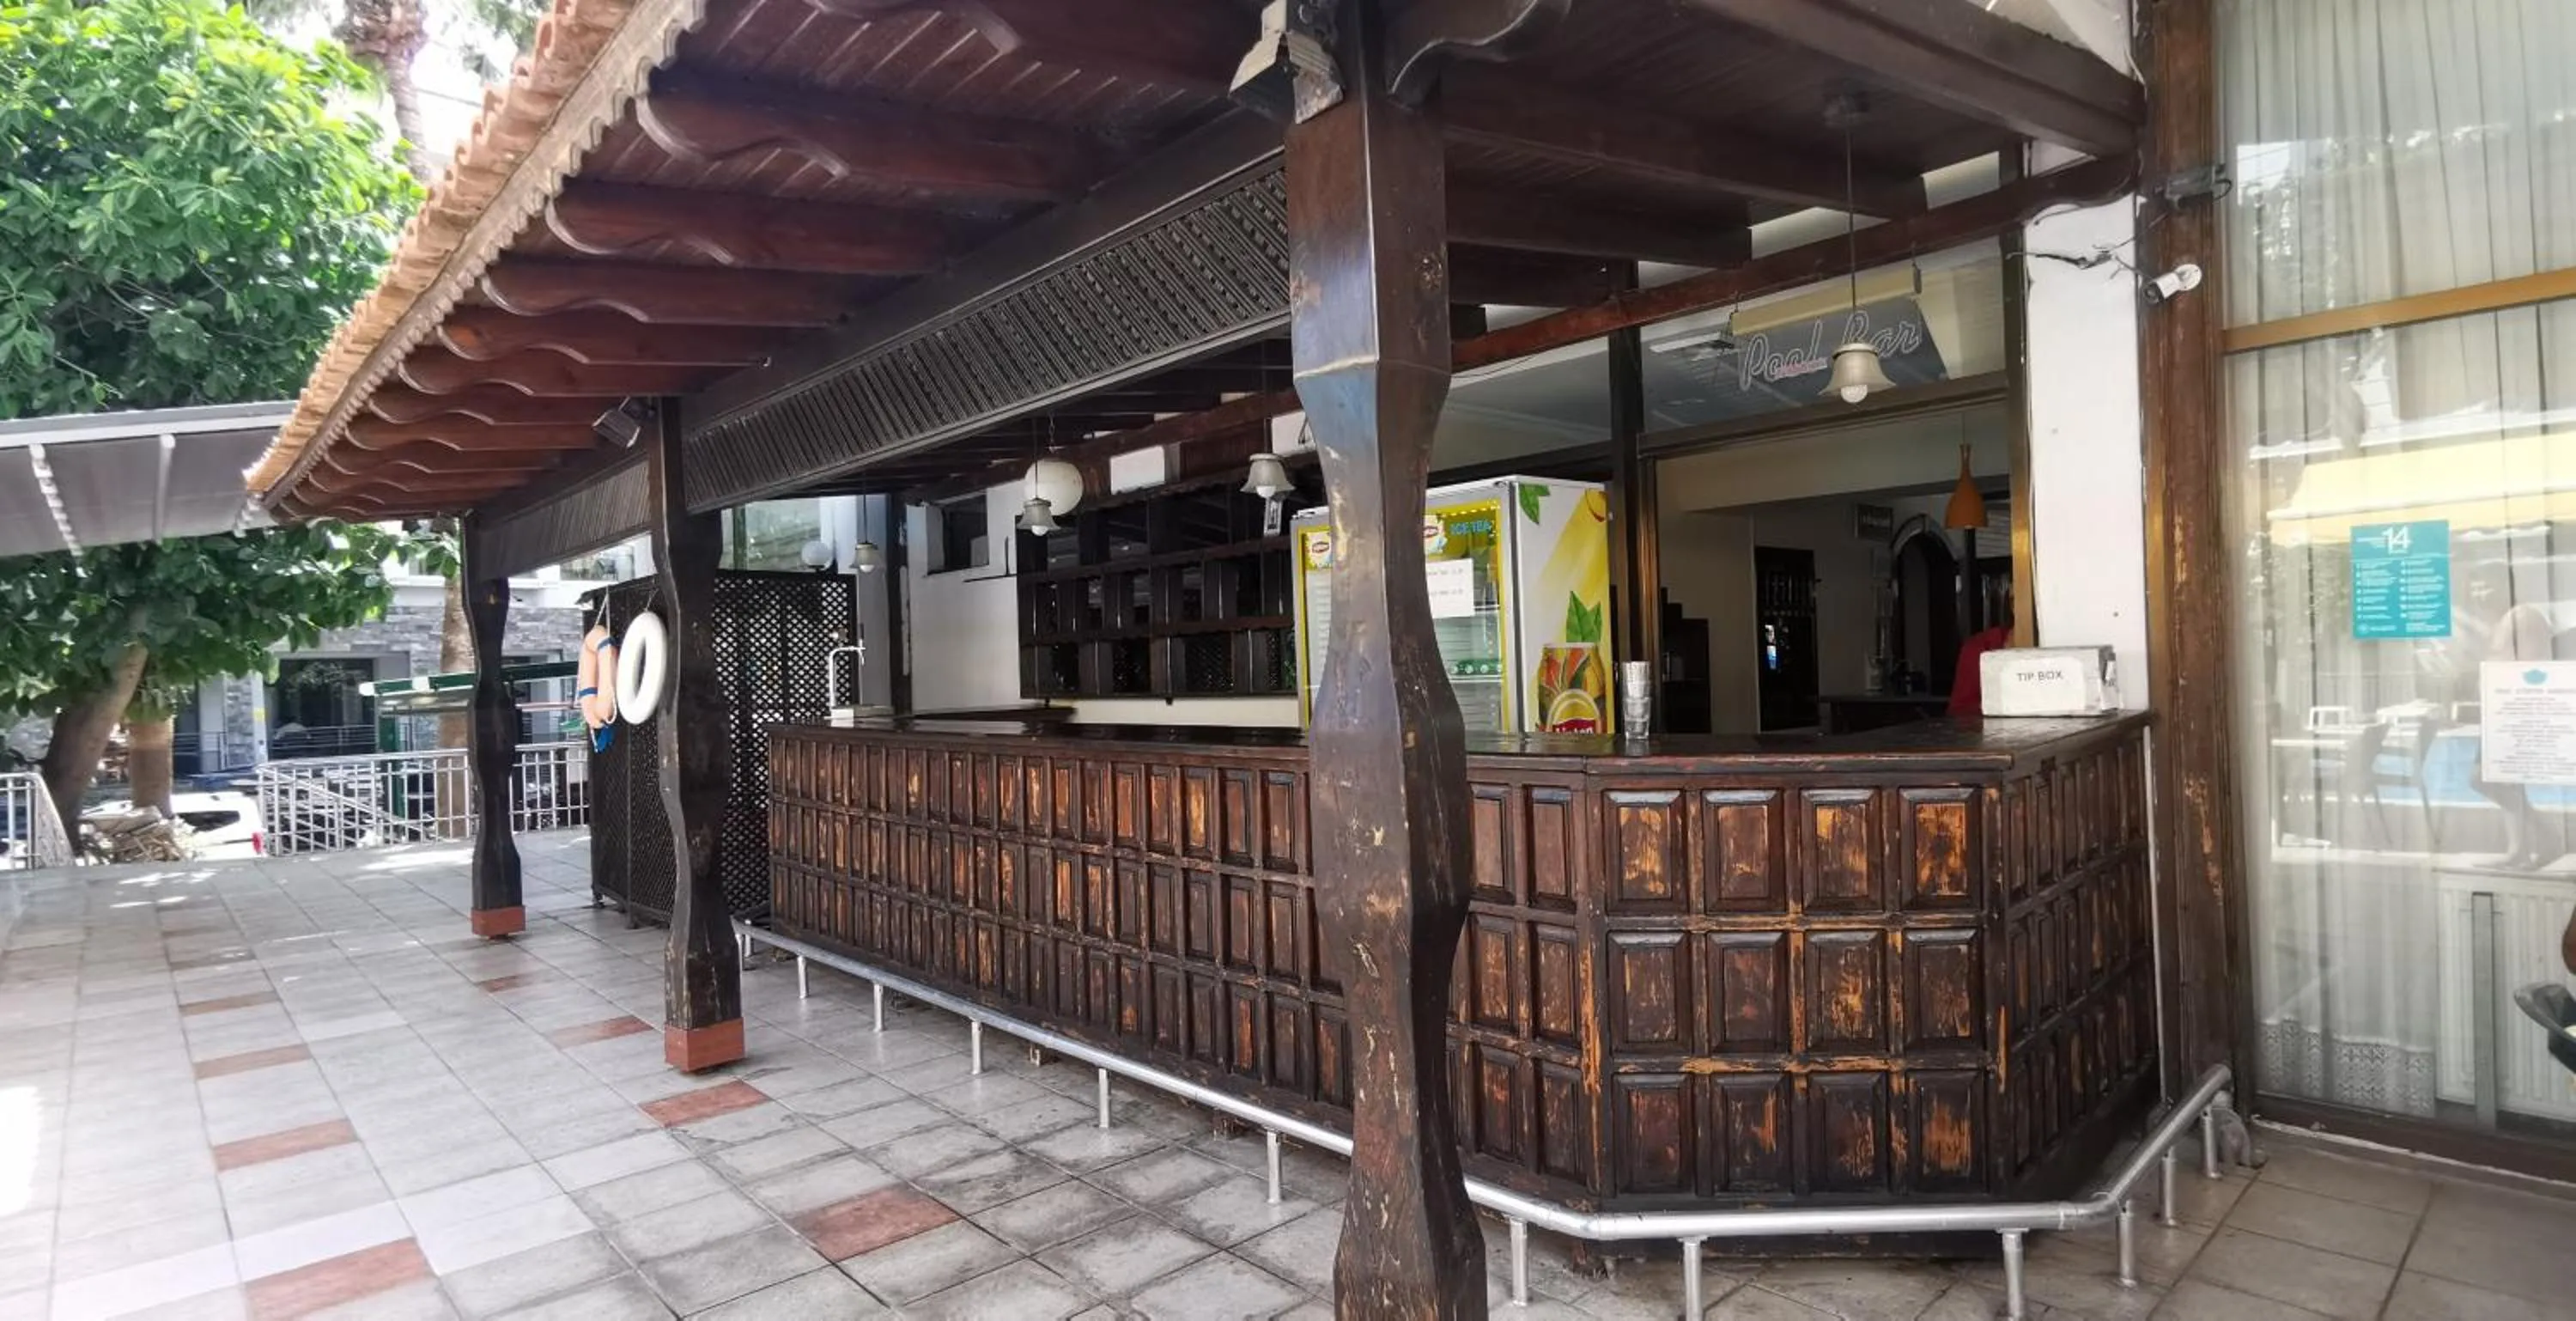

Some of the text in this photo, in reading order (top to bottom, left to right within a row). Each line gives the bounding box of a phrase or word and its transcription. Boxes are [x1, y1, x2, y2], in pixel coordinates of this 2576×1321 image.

[1739, 319, 1826, 391] Pool
[2381, 526, 2413, 550] 14
[2016, 670, 2063, 682] TIP BOX
